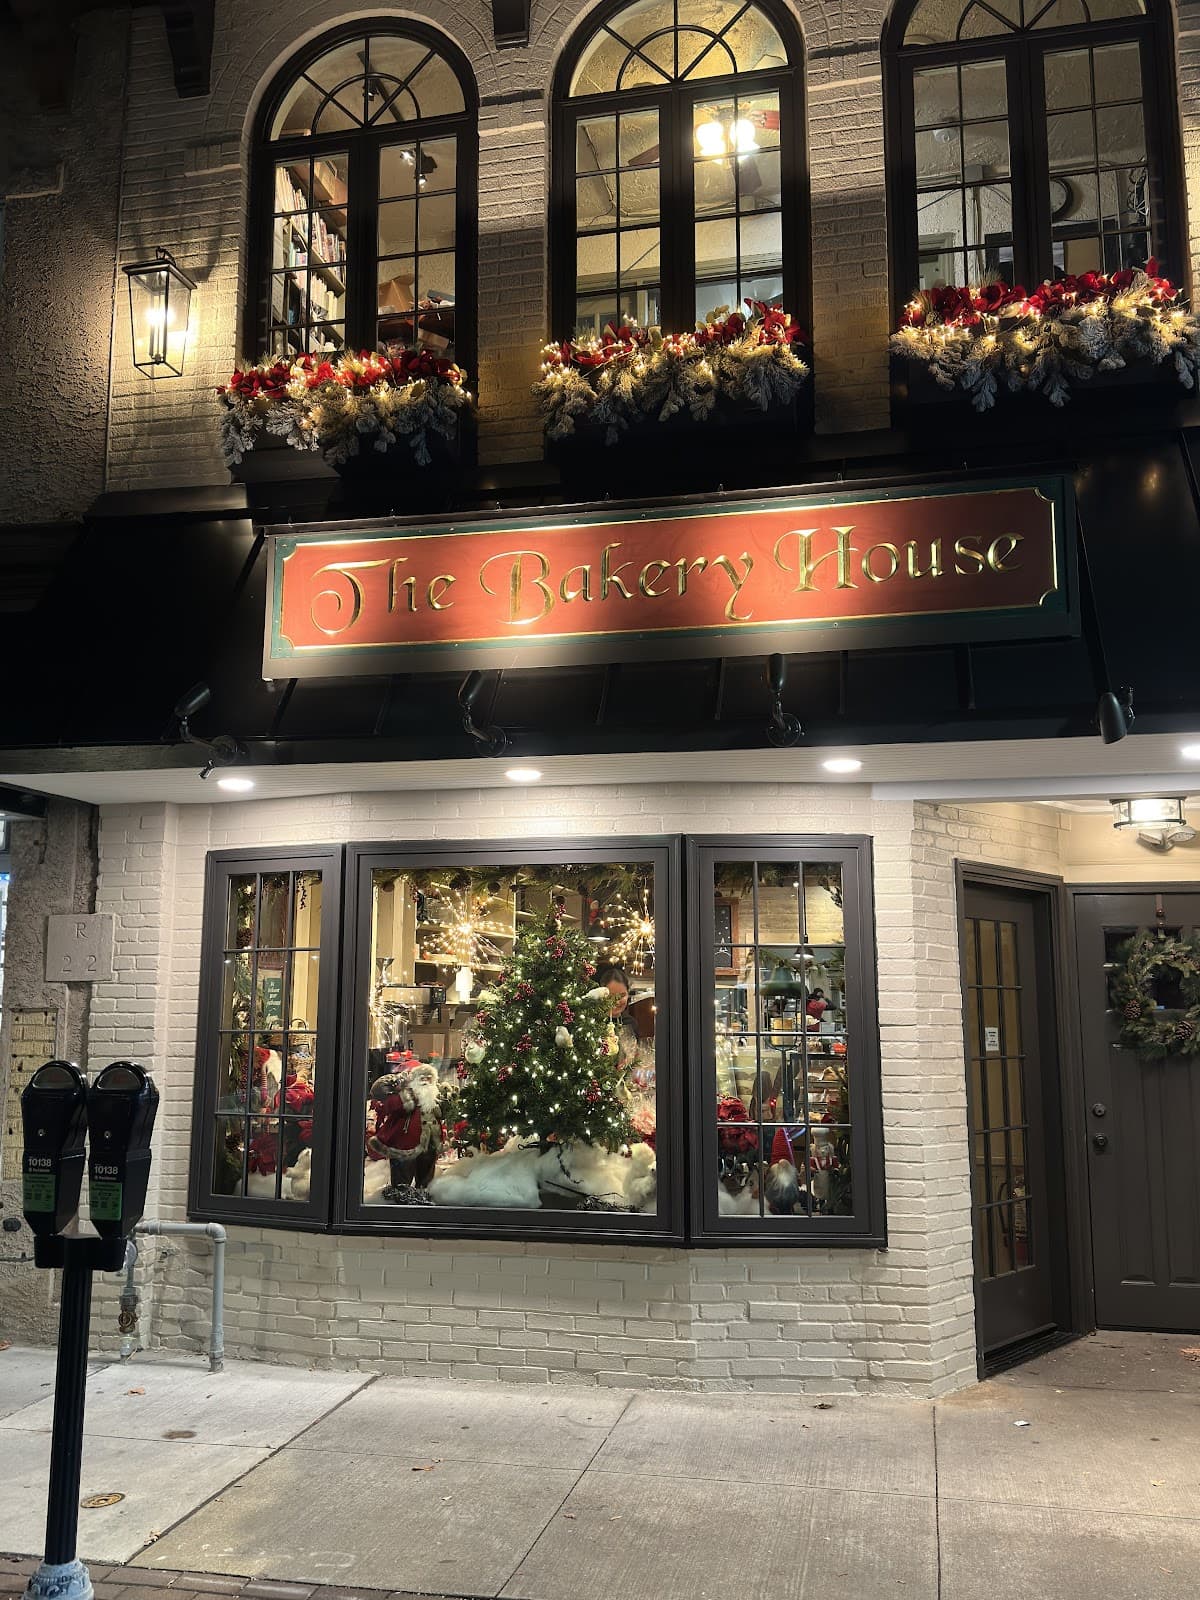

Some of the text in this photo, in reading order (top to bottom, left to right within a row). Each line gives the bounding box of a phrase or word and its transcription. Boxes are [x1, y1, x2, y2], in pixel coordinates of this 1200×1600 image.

[310, 525, 1025, 635] The Bakery House
[75, 922, 88, 939] R
[28, 1158, 52, 1167] 10138
[94, 1166, 119, 1175] 10138
